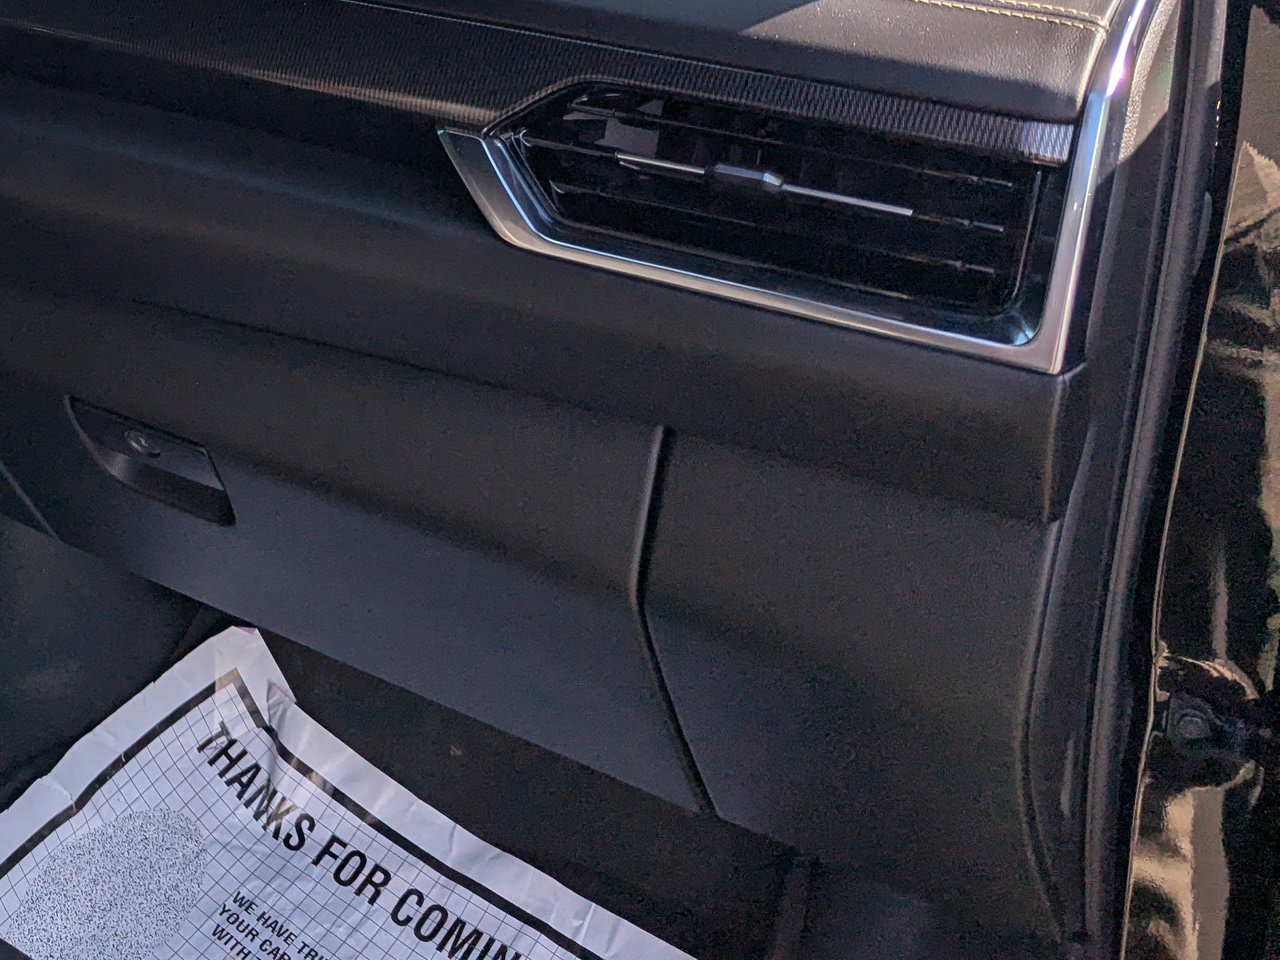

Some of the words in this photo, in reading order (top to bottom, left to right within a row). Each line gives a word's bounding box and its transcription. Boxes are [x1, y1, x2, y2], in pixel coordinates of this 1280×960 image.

[196, 720, 316, 852] THANKS
[311, 834, 392, 907] FOR
[211, 924, 253, 960] WITH
[218, 903, 260, 943] YOUR
[232, 890, 259, 916] WE
[256, 911, 298, 946] HAVE
